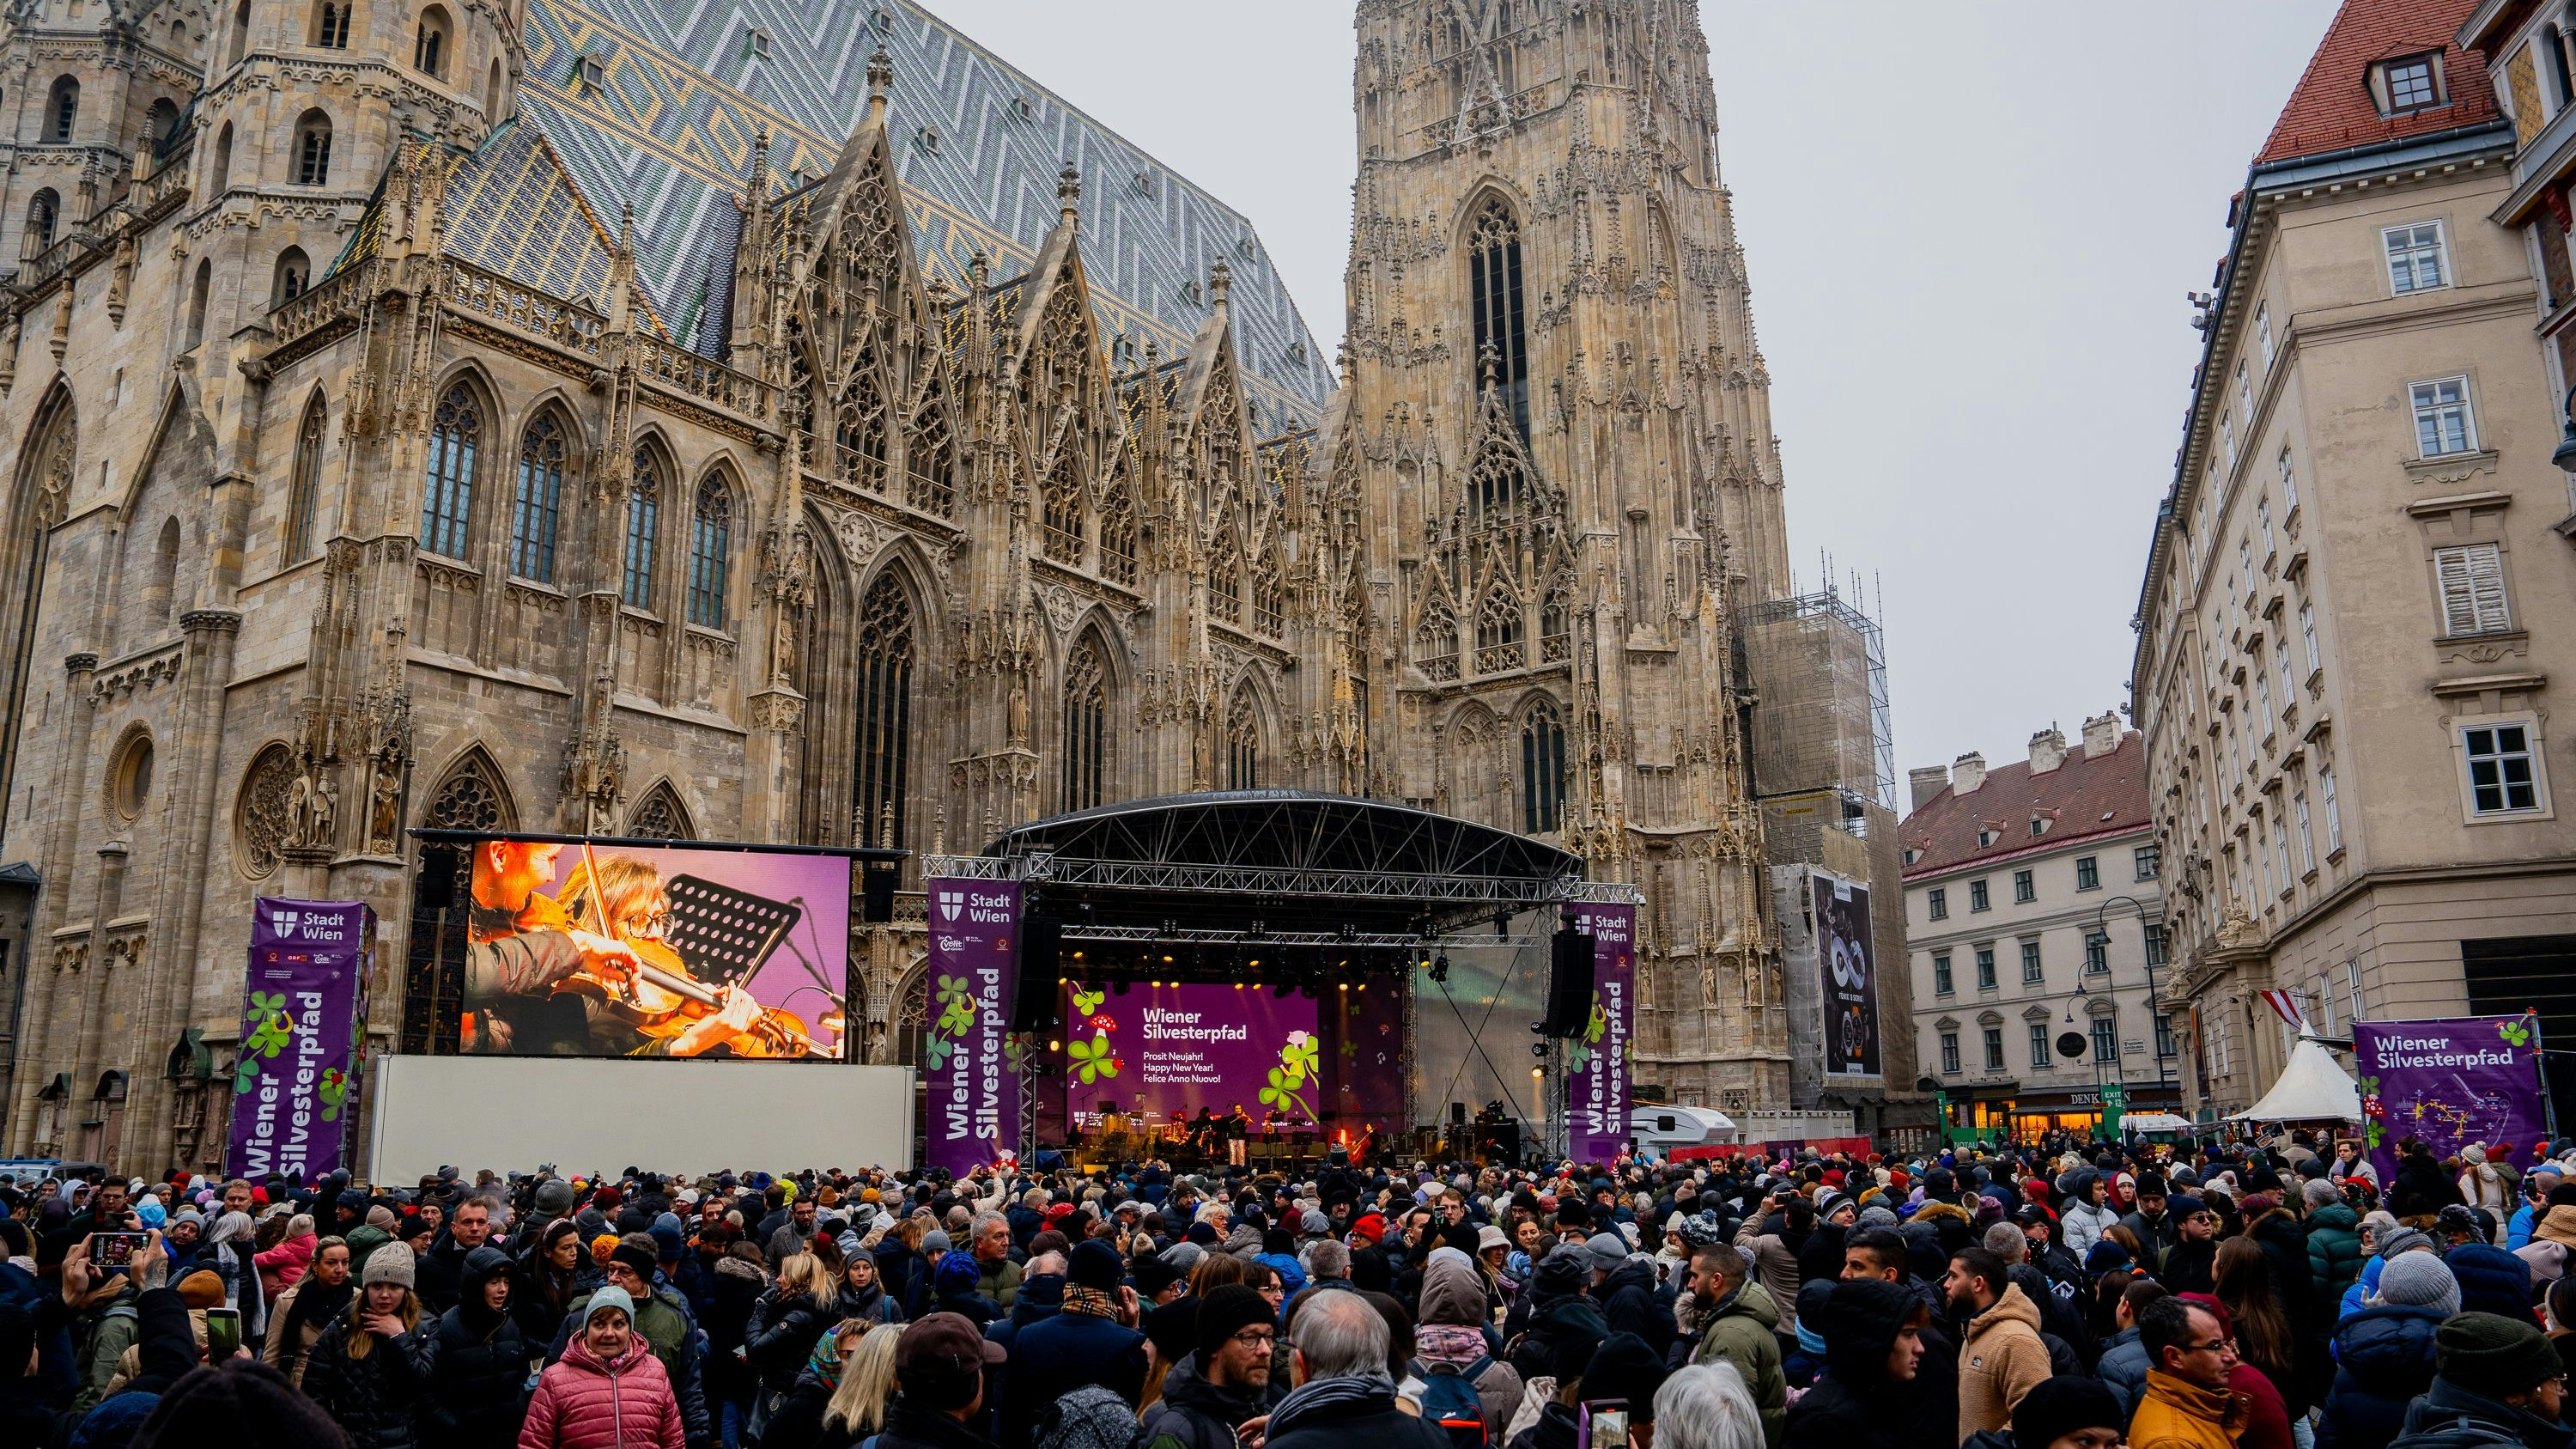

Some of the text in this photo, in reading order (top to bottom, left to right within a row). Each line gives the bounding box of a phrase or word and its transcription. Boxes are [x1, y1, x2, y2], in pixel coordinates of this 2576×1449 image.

[970, 892, 1011, 908] Stadt
[302, 912, 344, 926] Stadt
[969, 908, 1010, 922] Wien
[1595, 915, 1627, 928] Stadt
[302, 927, 343, 940] Wien
[1596, 928, 1627, 942] Wien
[1143, 1008, 1202, 1024] Wiener
[1143, 1024, 1247, 1044] Silvesterpfad
[2374, 1035, 2450, 1051] Wiener
[975, 968, 1005, 1139] Silvesterpfad
[1143, 1051, 1204, 1062] Prosit Neujahr!
[1605, 982, 1626, 1134] Silvesterpfad
[2377, 1048, 2514, 1070] Silvesterpfad
[1143, 1062, 1213, 1074] Happy New Year!
[279, 991, 325, 1179] Silvesterpfad
[1143, 1074, 1221, 1083] Felice Anno Nuovo!
[945, 1043, 969, 1141] Wiener
[1586, 1049, 1603, 1135] Wiener
[244, 1073, 279, 1178] Wiener
